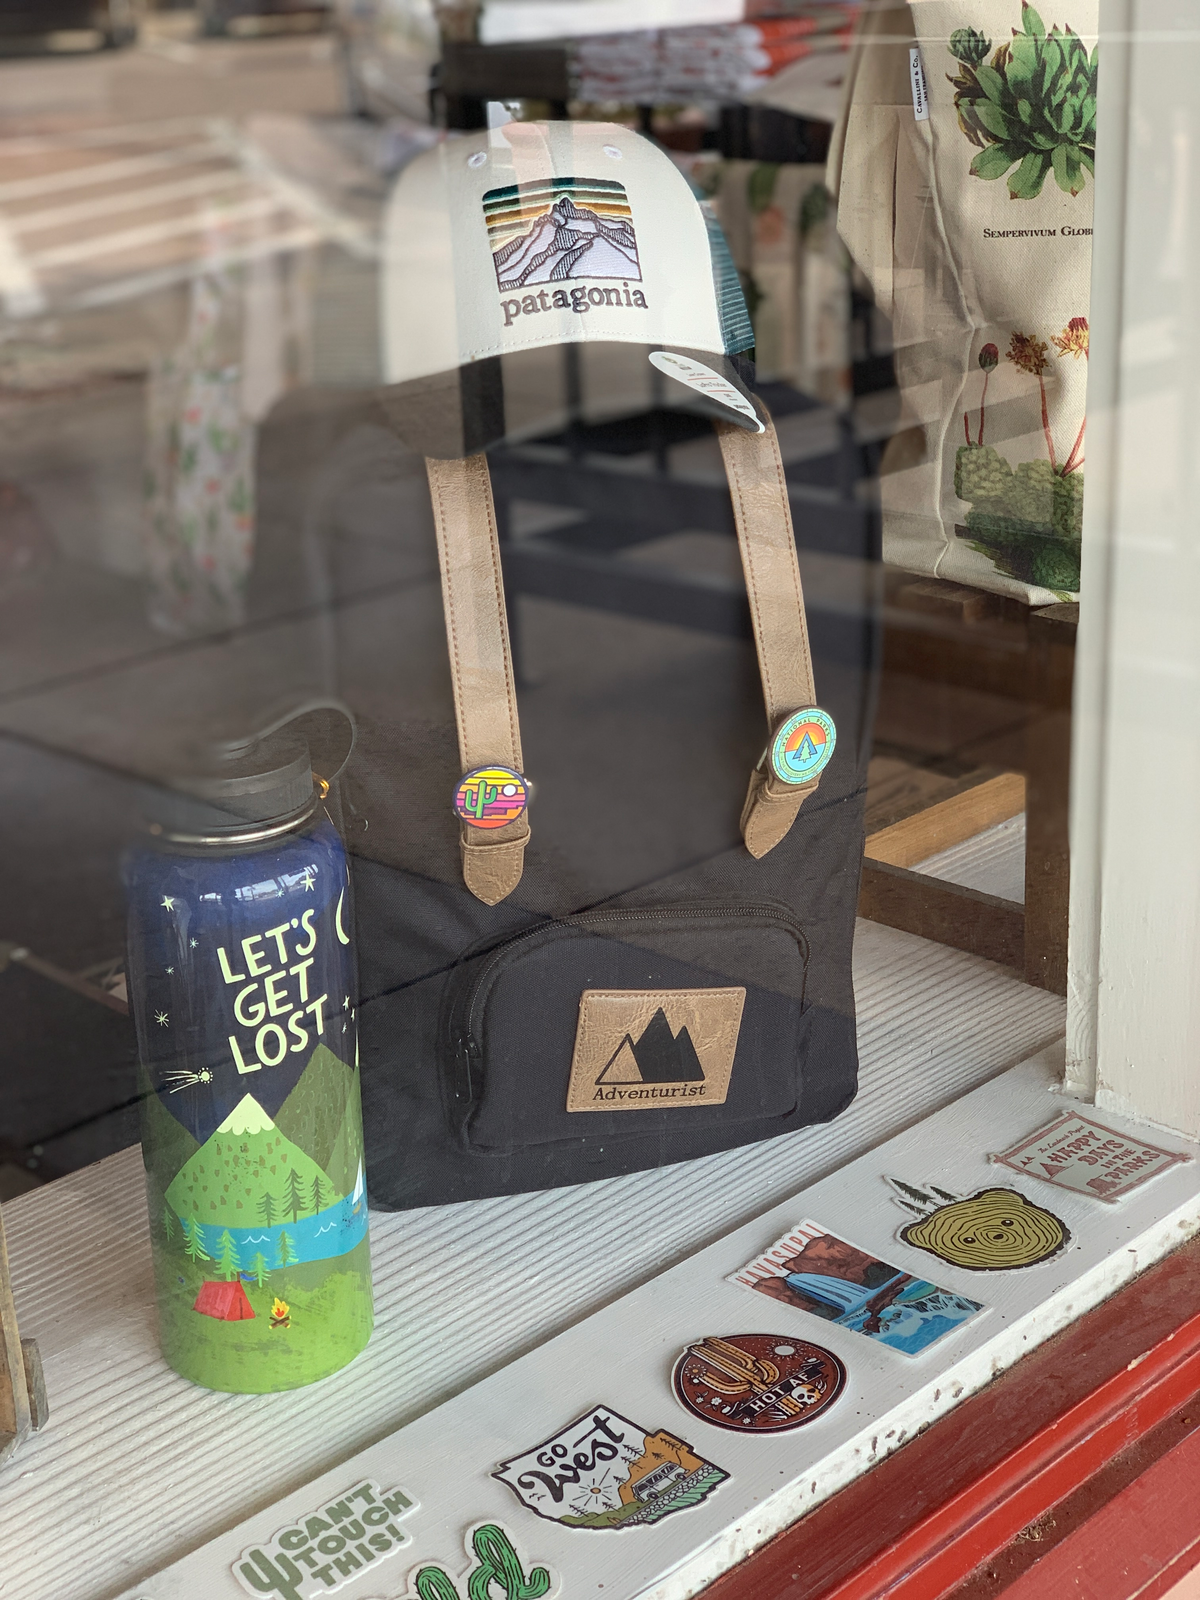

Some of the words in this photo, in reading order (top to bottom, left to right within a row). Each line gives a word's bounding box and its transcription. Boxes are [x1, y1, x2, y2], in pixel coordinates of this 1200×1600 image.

[915, 78, 923, 114] CAVALLINI
[983, 228, 1057, 238] SEMPERVIVUM
[500, 281, 649, 327] patagonia
[781, 717, 811, 747] NATIONAL
[816, 718, 831, 737] PARKS
[216, 908, 317, 984] LET'S
[233, 957, 314, 1027] GET
[228, 993, 328, 1075] LOST
[592, 1083, 707, 1101] Adventurist
[1046, 1130, 1102, 1163] HAPPY
[1077, 1139, 1125, 1166] DAYS
[1100, 1154, 1118, 1169] IN
[1111, 1148, 1137, 1162] THE
[1104, 1149, 1161, 1181] PARKS
[734, 1223, 826, 1288] HAVASUPAI
[749, 1385, 786, 1411] HOT
[790, 1372, 808, 1387] AF
[536, 1443, 568, 1467] GO
[278, 1483, 377, 1551] CAN'T
[291, 1490, 413, 1569] TOUCH
[310, 1523, 405, 1587] THIS!
